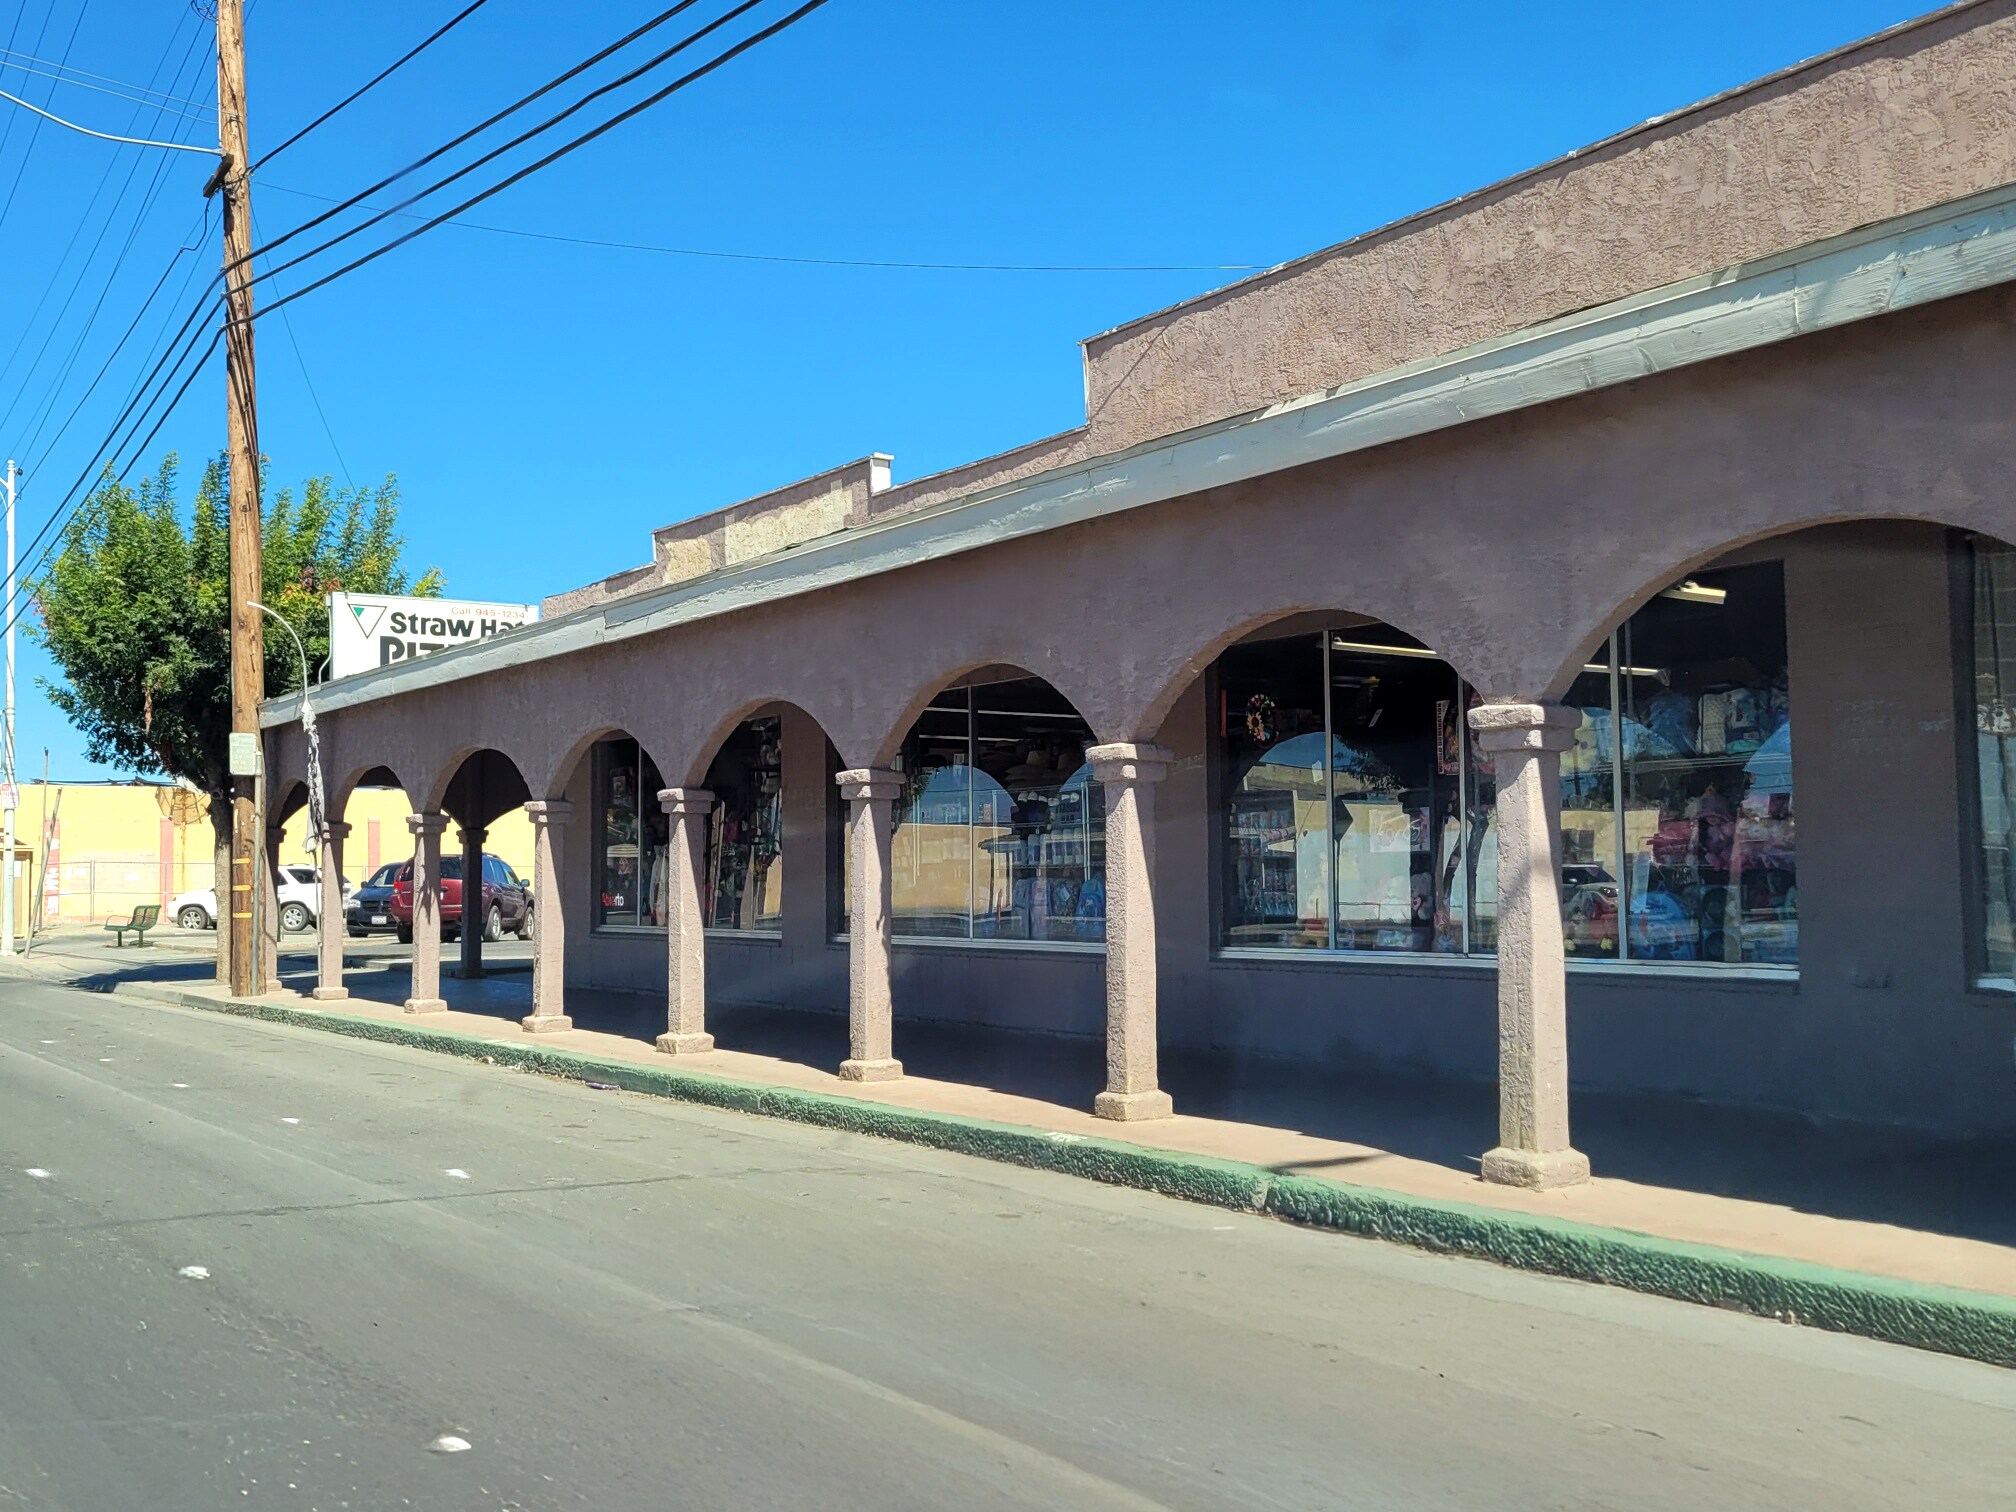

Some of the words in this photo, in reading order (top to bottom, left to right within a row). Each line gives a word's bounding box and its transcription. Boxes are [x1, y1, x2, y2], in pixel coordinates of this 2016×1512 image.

[451, 607, 471, 615] Call
[390, 611, 475, 637] Straw
[480, 618, 525, 638] Ha
